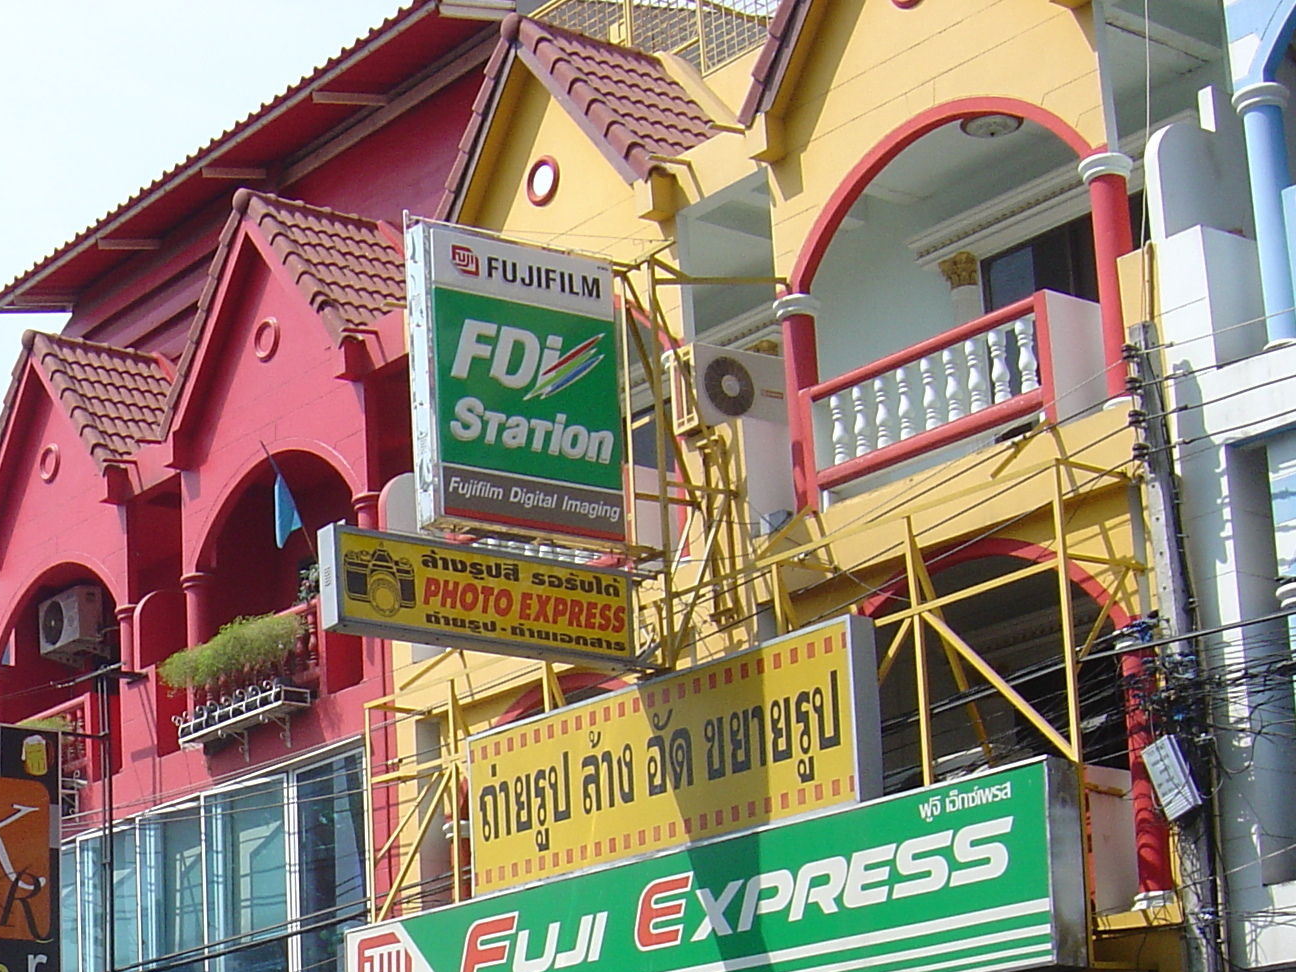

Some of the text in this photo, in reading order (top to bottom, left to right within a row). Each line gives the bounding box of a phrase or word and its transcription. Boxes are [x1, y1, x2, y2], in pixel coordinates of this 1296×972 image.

[487, 256, 601, 300] FUJIFILM
[448, 476, 621, 522] Fujifilm Digital Imaging
[421, 549, 621, 598] ล้างรูปสี รอรับได้
[422, 577, 626, 634] PHOTO EXPRESS
[425, 611, 626, 651] ถ่ายรูป ถ่ายเอกสาร
[479, 669, 842, 852] ถ่ายรูป ล้าง อัด ขยายรูป
[919, 781, 1011, 822] ฟูจิ เอ็กซ์เพรส
[633, 815, 1015, 952] EXPRESS
